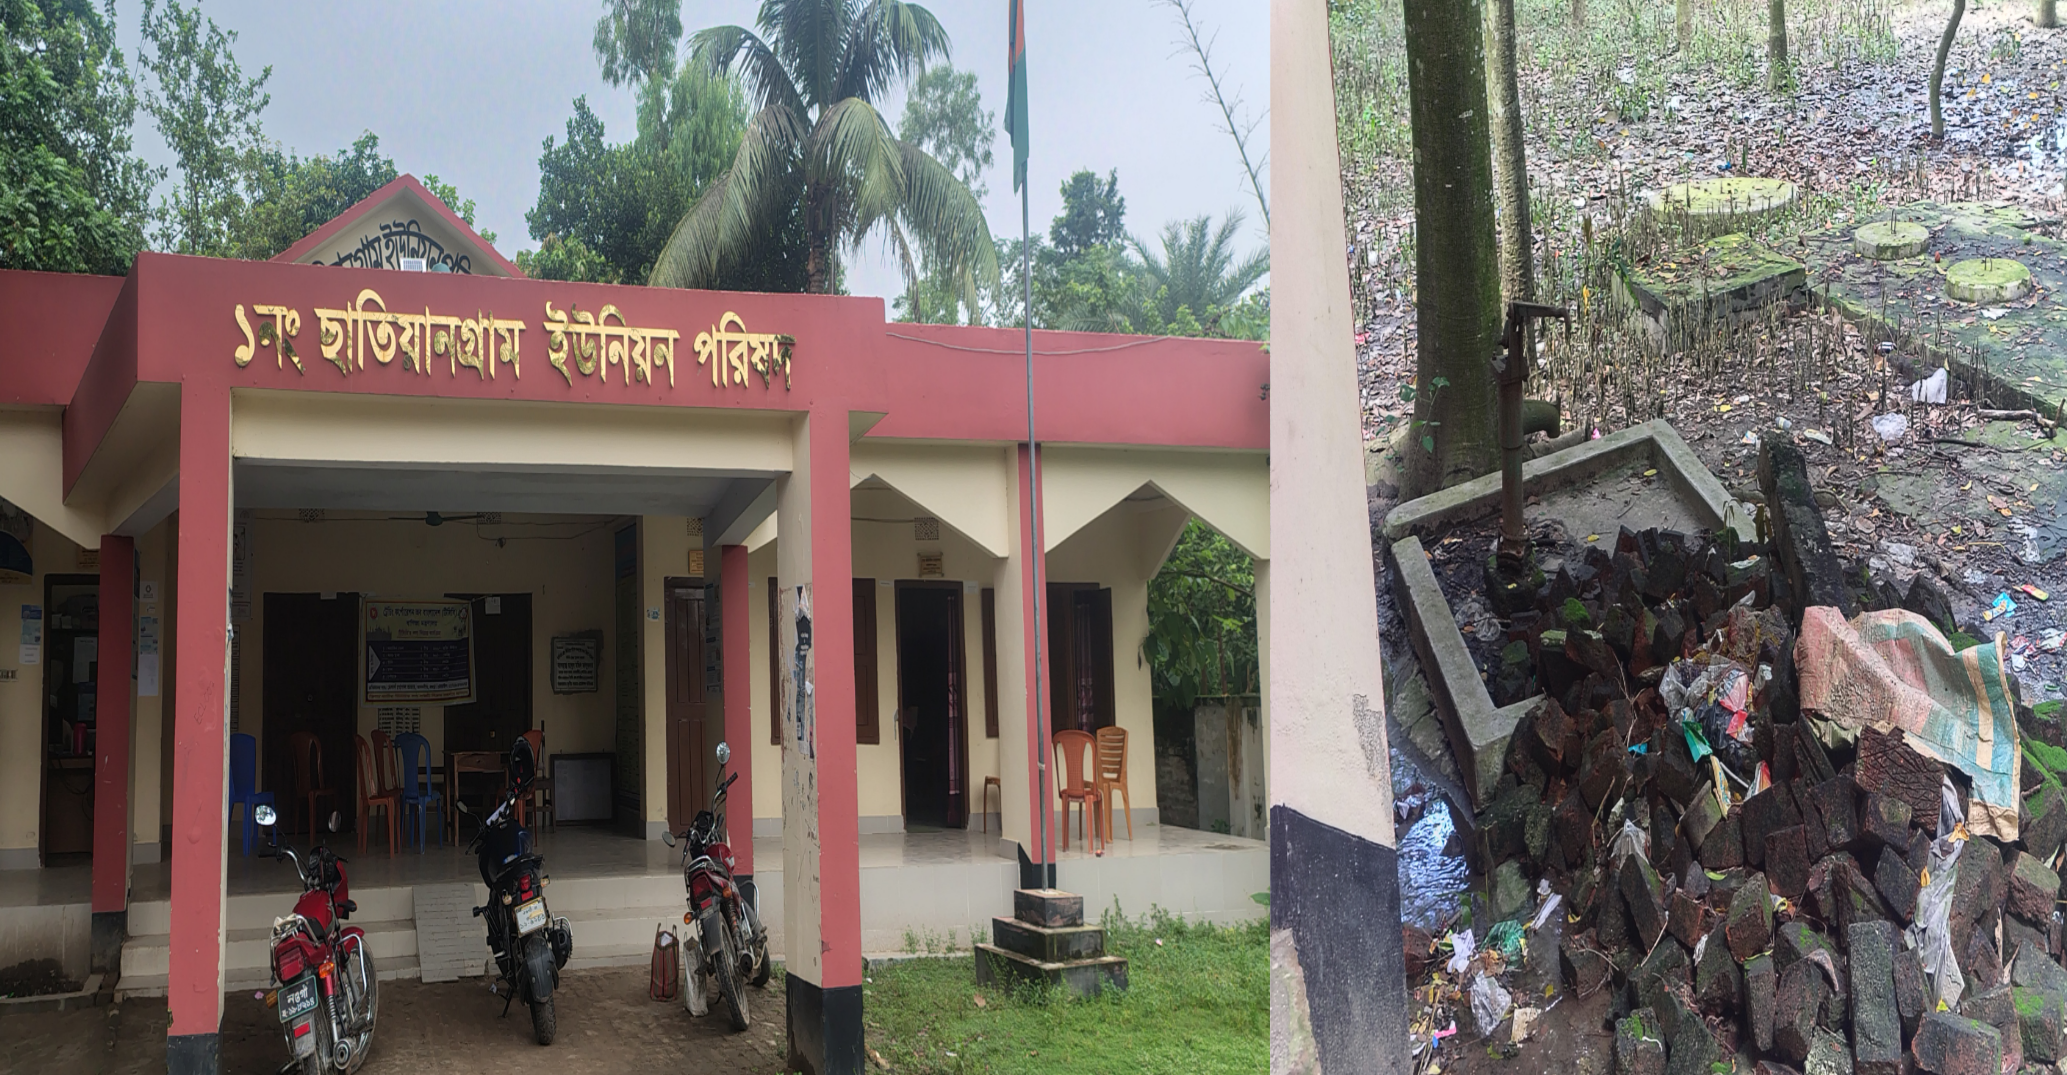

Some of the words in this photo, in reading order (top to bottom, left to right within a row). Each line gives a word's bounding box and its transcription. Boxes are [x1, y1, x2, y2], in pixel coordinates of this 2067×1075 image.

[234, 303, 304, 376] ১নং
[314, 288, 526, 380] ছাতিয়ানগ্রাম
[543, 301, 680, 388] ইউনিয়ন
[693, 311, 796, 390] পরিষদ
[286, 984, 309, 1005] নওগাঁ
